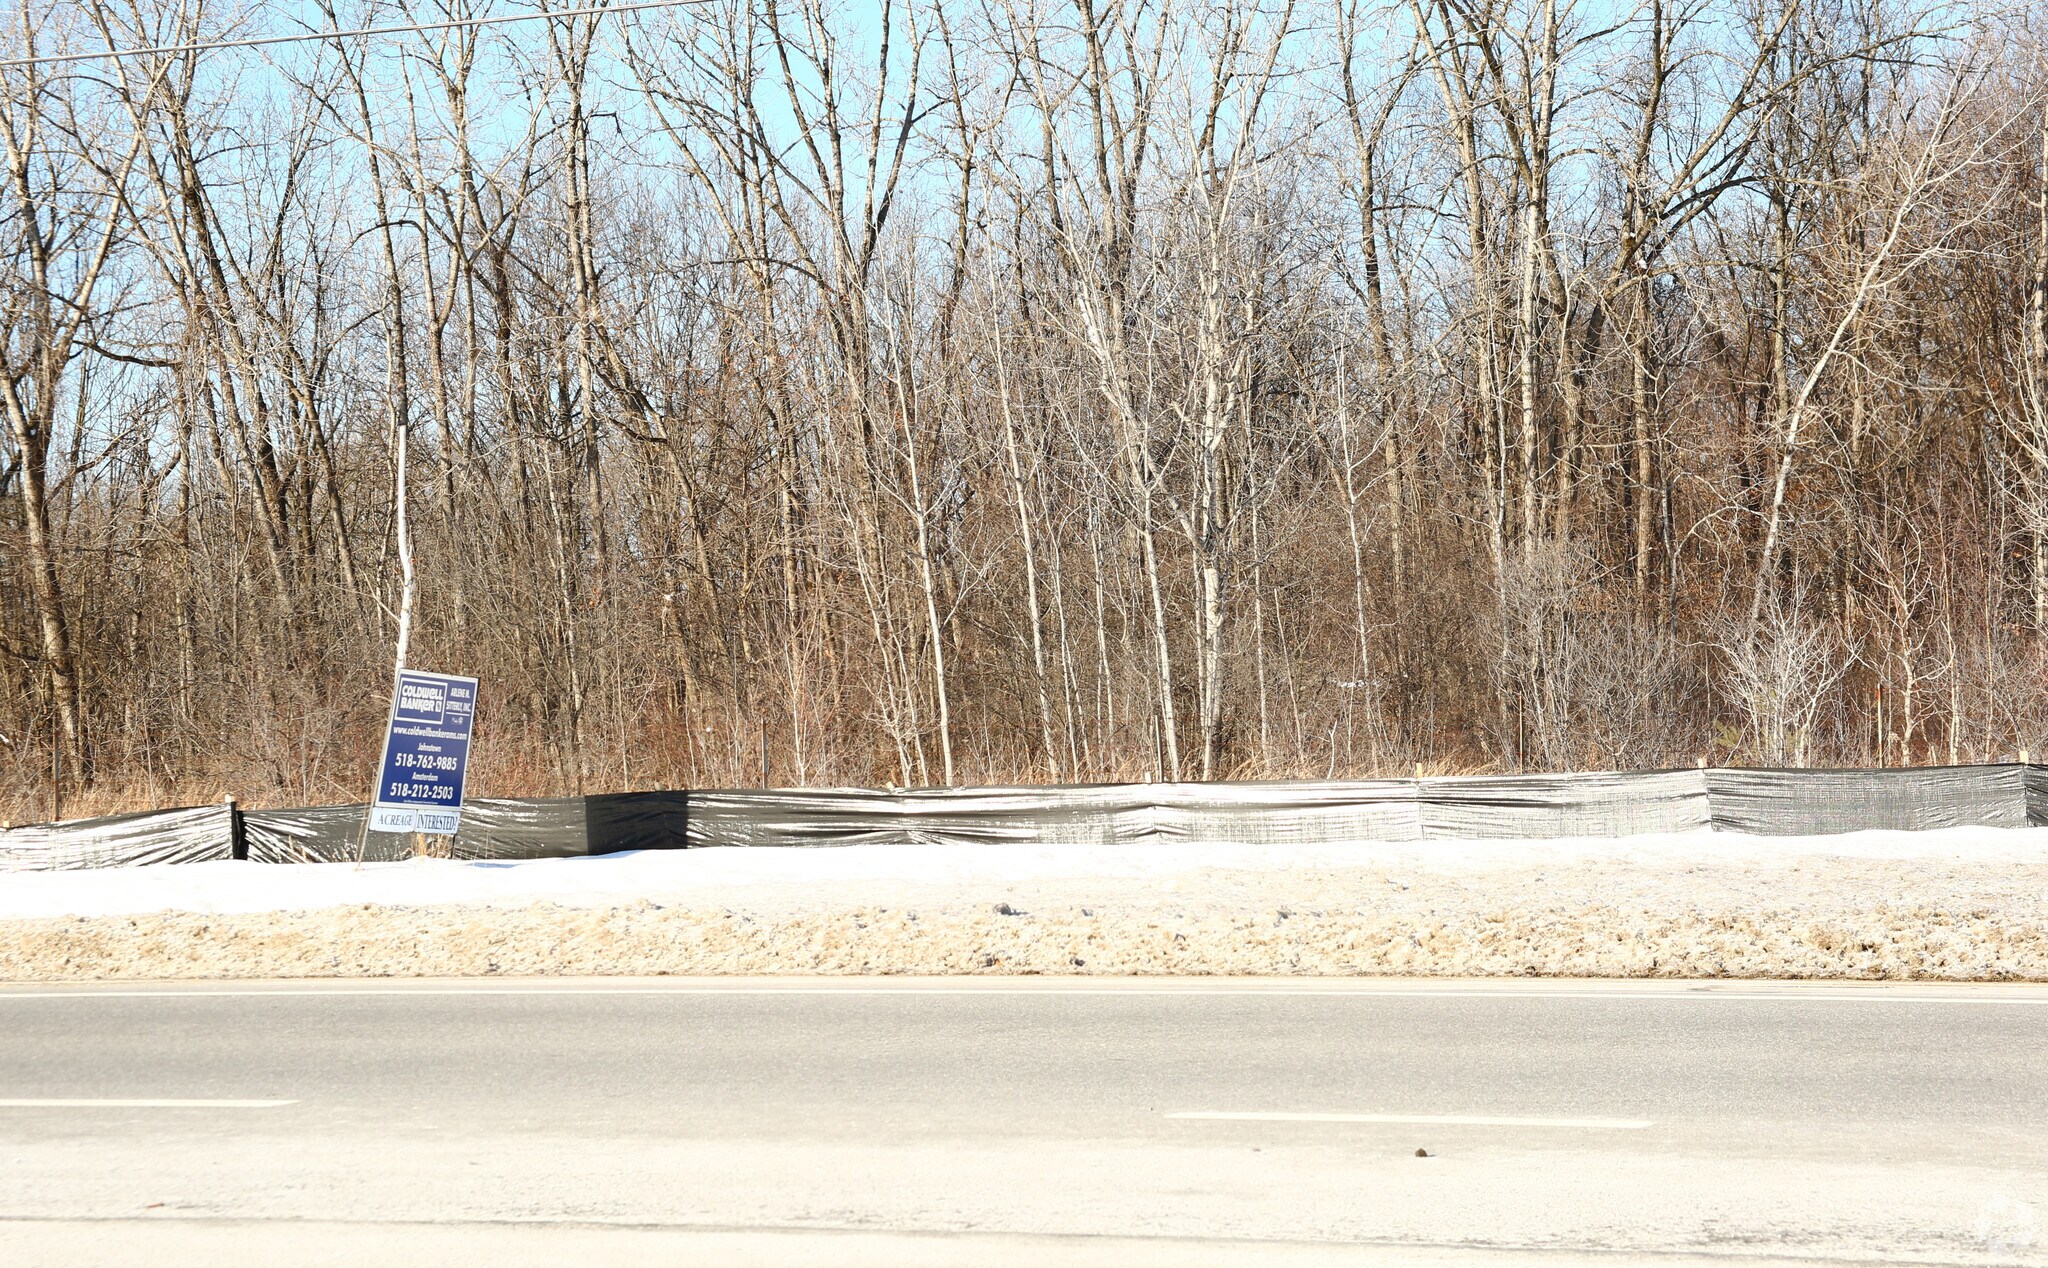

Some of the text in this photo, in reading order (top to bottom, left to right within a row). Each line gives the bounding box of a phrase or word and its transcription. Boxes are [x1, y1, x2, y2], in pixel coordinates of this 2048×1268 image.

[402, 685, 443, 700] COLDWELL
[400, 697, 435, 712] BANKER
[417, 742, 441, 752] Johnstown
[395, 753, 457, 771] 518-762-9885
[412, 772, 438, 781] Amsterdam
[390, 783, 453, 799] 518-212-2503
[378, 814, 412, 826] ACREAGE
